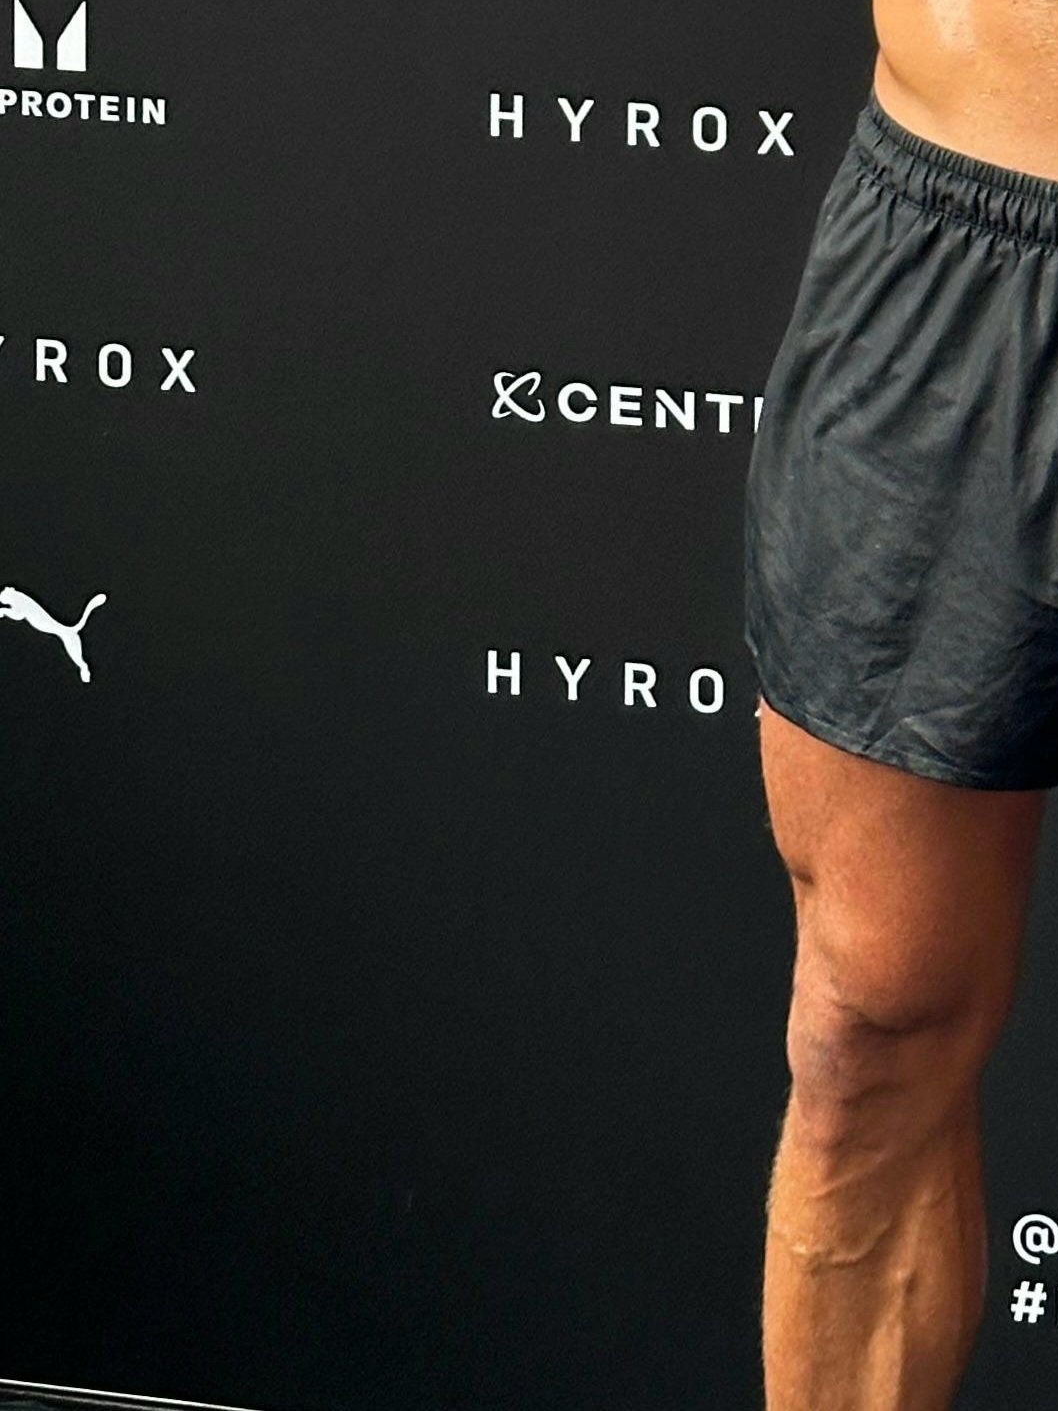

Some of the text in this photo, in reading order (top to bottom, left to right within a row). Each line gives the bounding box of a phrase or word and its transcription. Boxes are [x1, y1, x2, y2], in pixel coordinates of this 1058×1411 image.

[0, 88, 166, 125] PROTEIN
[489, 93, 794, 156] HYROX
[0, 335, 196, 393] ROX
[557, 382, 764, 434] CENT
[487, 650, 764, 717] HYRO
